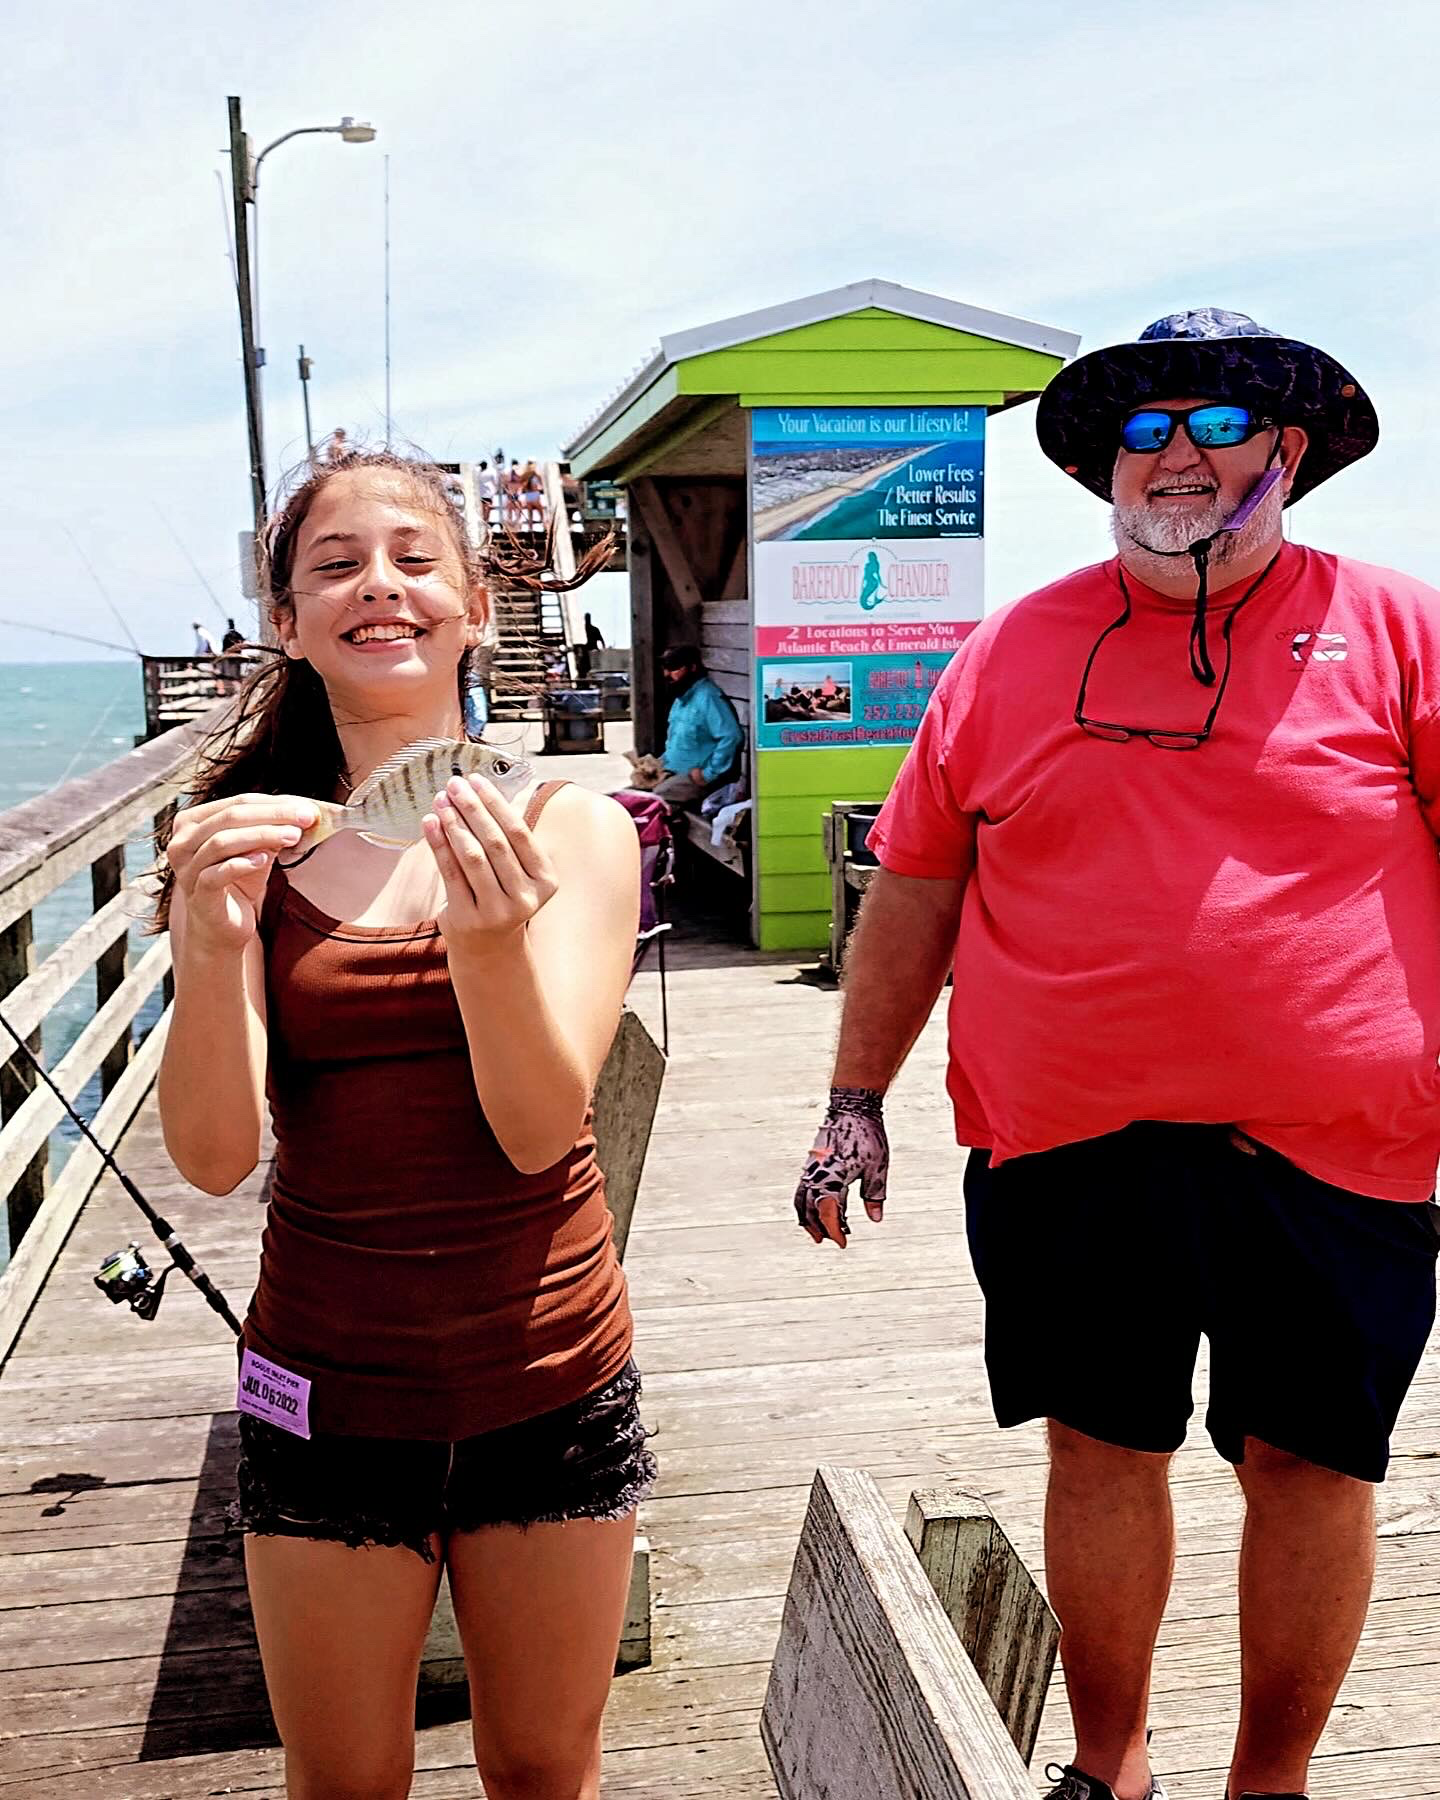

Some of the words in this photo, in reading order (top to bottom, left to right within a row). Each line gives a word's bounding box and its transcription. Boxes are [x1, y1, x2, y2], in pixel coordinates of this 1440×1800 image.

[778, 413, 810, 433] Your
[812, 413, 866, 433] Vacation
[870, 414, 881, 433] is
[884, 417, 906, 433] our
[909, 411, 969, 433] Lifestyle!
[908, 465, 945, 483] Lower
[948, 463, 974, 482] Fees
[896, 485, 931, 506] Better
[934, 485, 976, 504] Results
[877, 508, 899, 527] The
[900, 508, 932, 526] Finest
[935, 508, 976, 526] Service
[792, 565, 859, 600] BAREFOOT
[887, 563, 951, 599] CHANDLER
[786, 626, 800, 639] 2
[806, 625, 868, 639] Locations
[871, 625, 885, 637] to
[887, 624, 926, 637] Serve
[928, 623, 956, 636] You
[776, 640, 827, 654] Atlantic
[829, 639, 869, 653] Beach
[871, 639, 886, 652] &
[888, 637, 938, 651] Emerald
[242, 1375, 261, 1398] JUL
